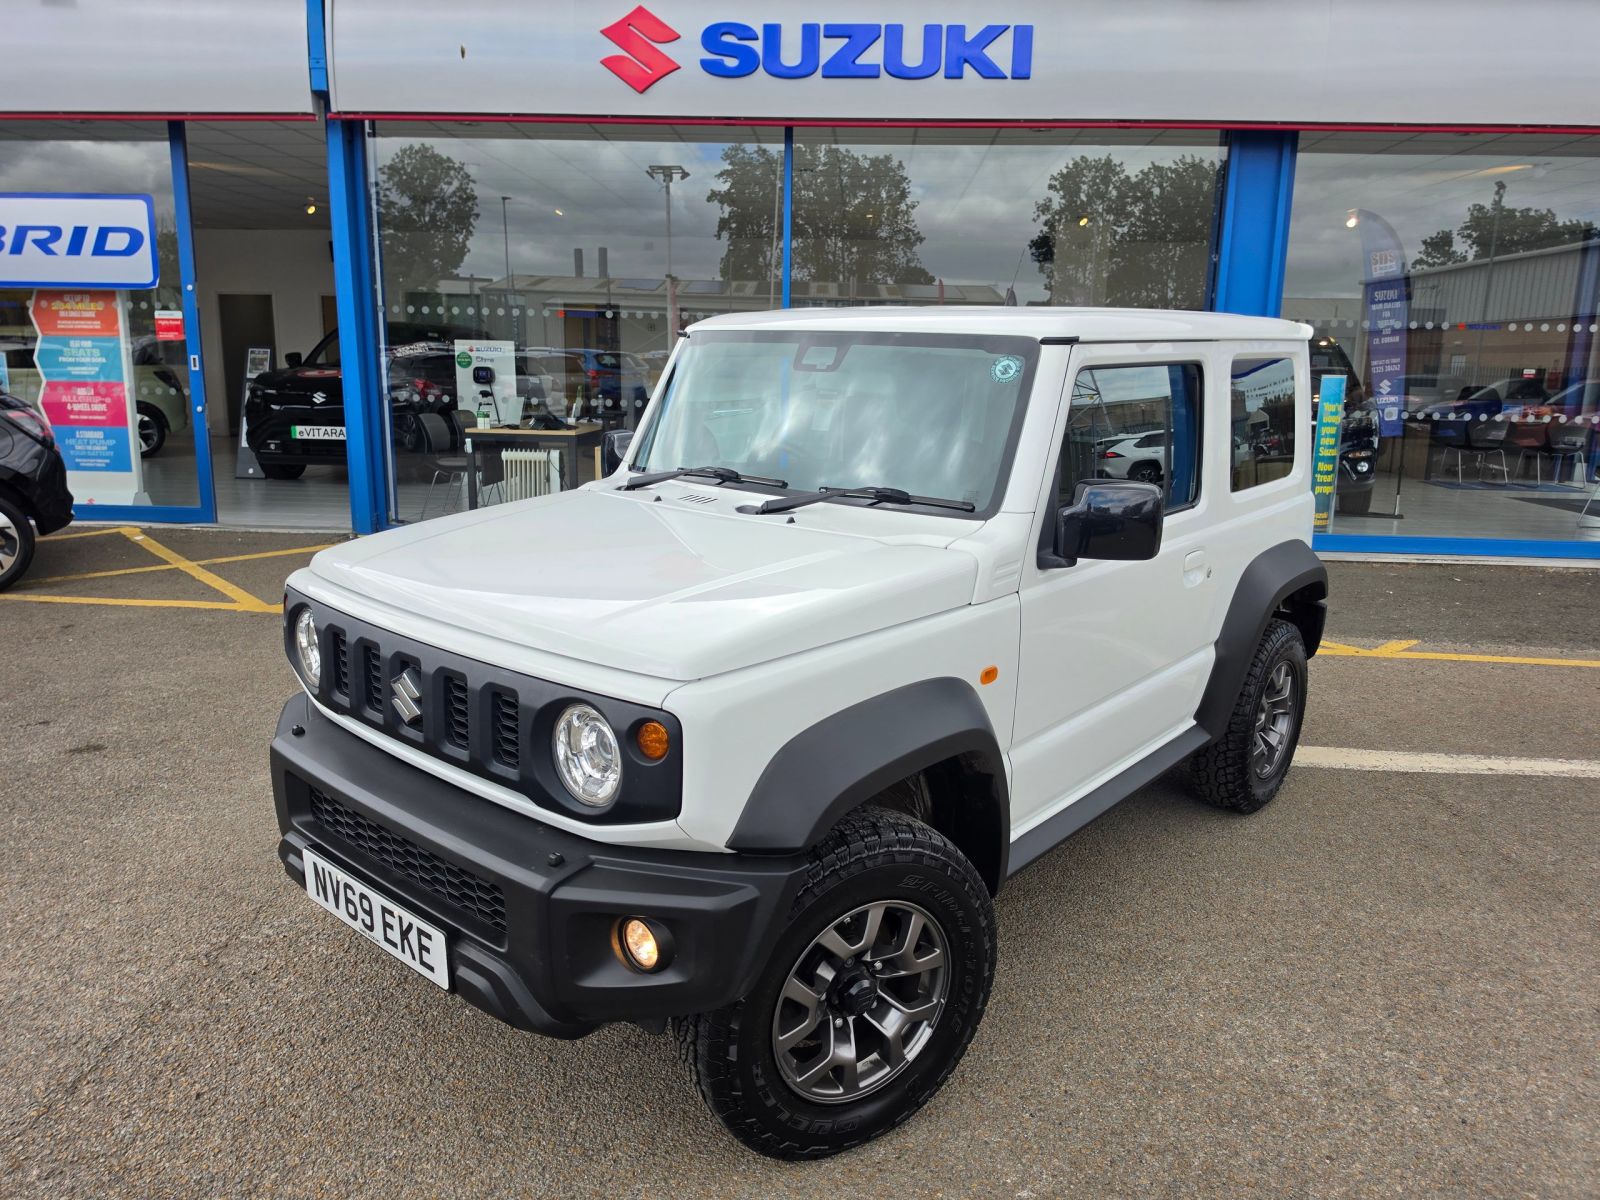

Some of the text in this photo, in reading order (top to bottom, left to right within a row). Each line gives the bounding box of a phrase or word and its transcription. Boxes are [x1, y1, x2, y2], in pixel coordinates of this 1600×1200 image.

[700, 21, 1034, 80] SUZUKI
[0, 225, 145, 257] RID
[312, 860, 436, 974] NV69 EKE
